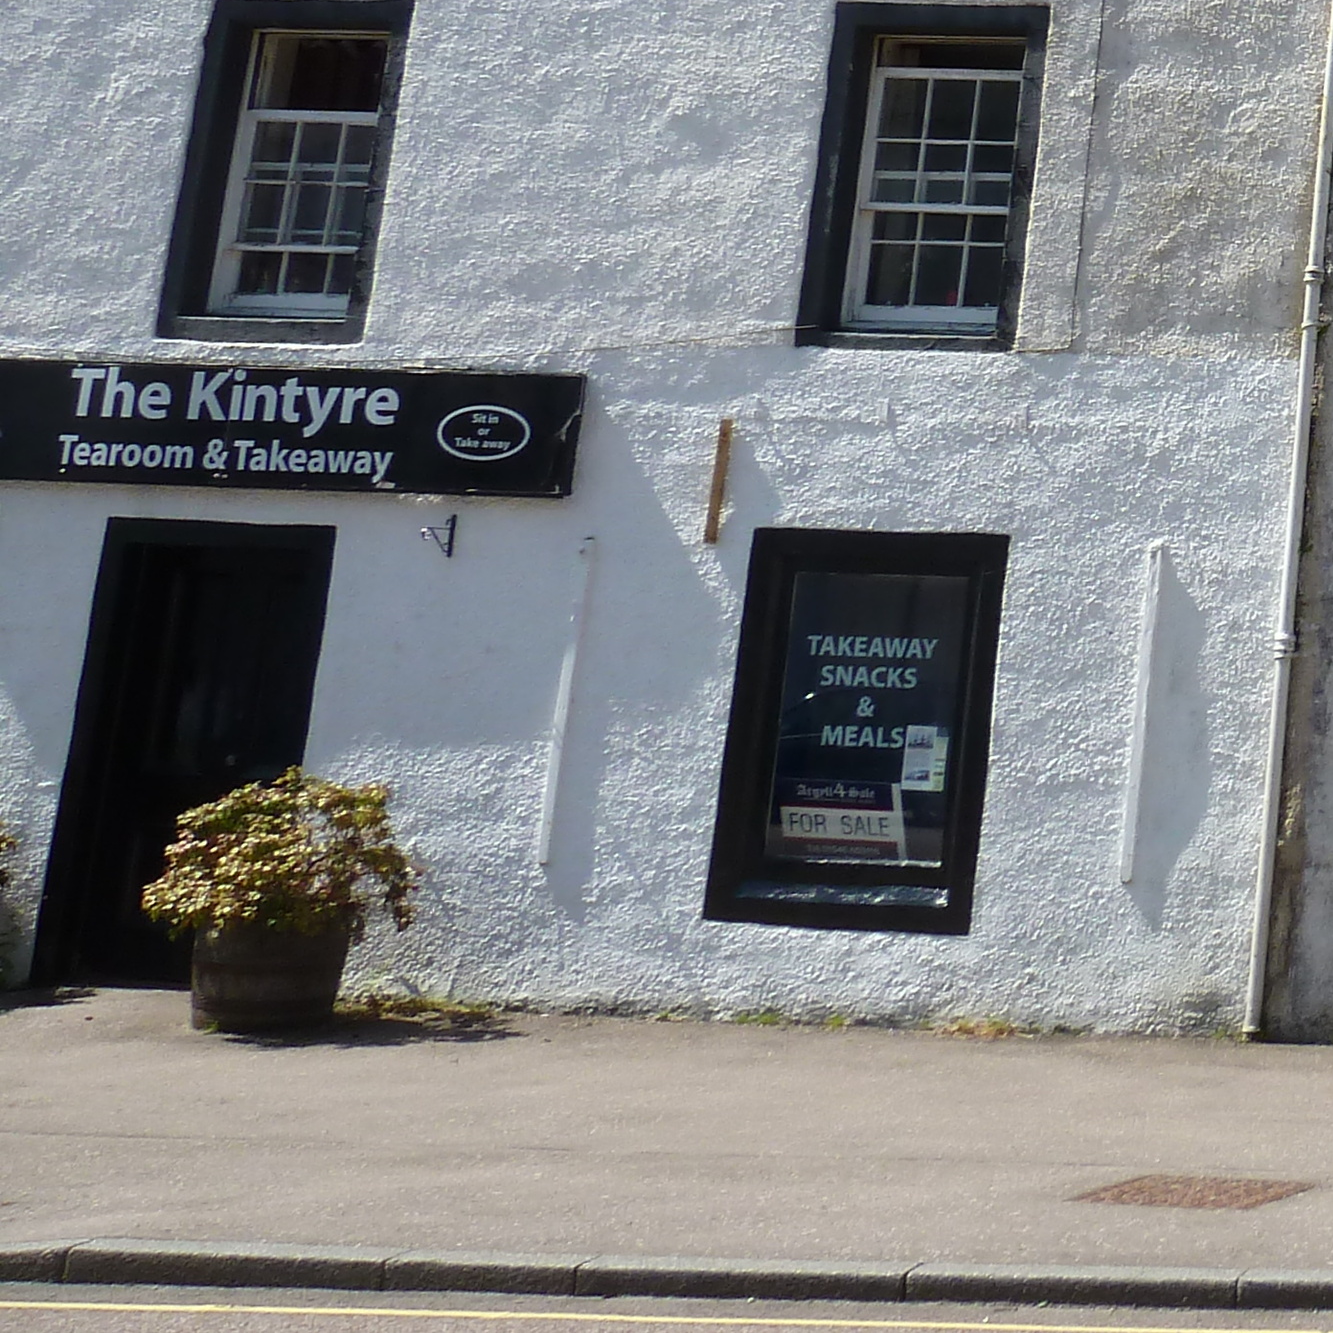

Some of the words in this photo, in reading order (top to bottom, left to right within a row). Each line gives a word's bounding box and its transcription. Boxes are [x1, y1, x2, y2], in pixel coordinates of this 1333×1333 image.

[71, 366, 172, 420] The
[186, 369, 400, 438] Kintyre
[471, 413, 487, 424] Sit
[488, 413, 500, 424] in
[454, 437, 480, 448] Take
[482, 440, 511, 451] away
[478, 428, 491, 436] or
[59, 434, 194, 469] Tearoom
[202, 438, 230, 471] &
[233, 439, 394, 484] Takeaway
[807, 634, 939, 659] TAKEAWAY
[820, 665, 918, 689] SNACKS
[856, 696, 875, 717] &
[820, 725, 904, 749] MEALS
[789, 812, 828, 834] FOR
[841, 815, 890, 837] SALE
